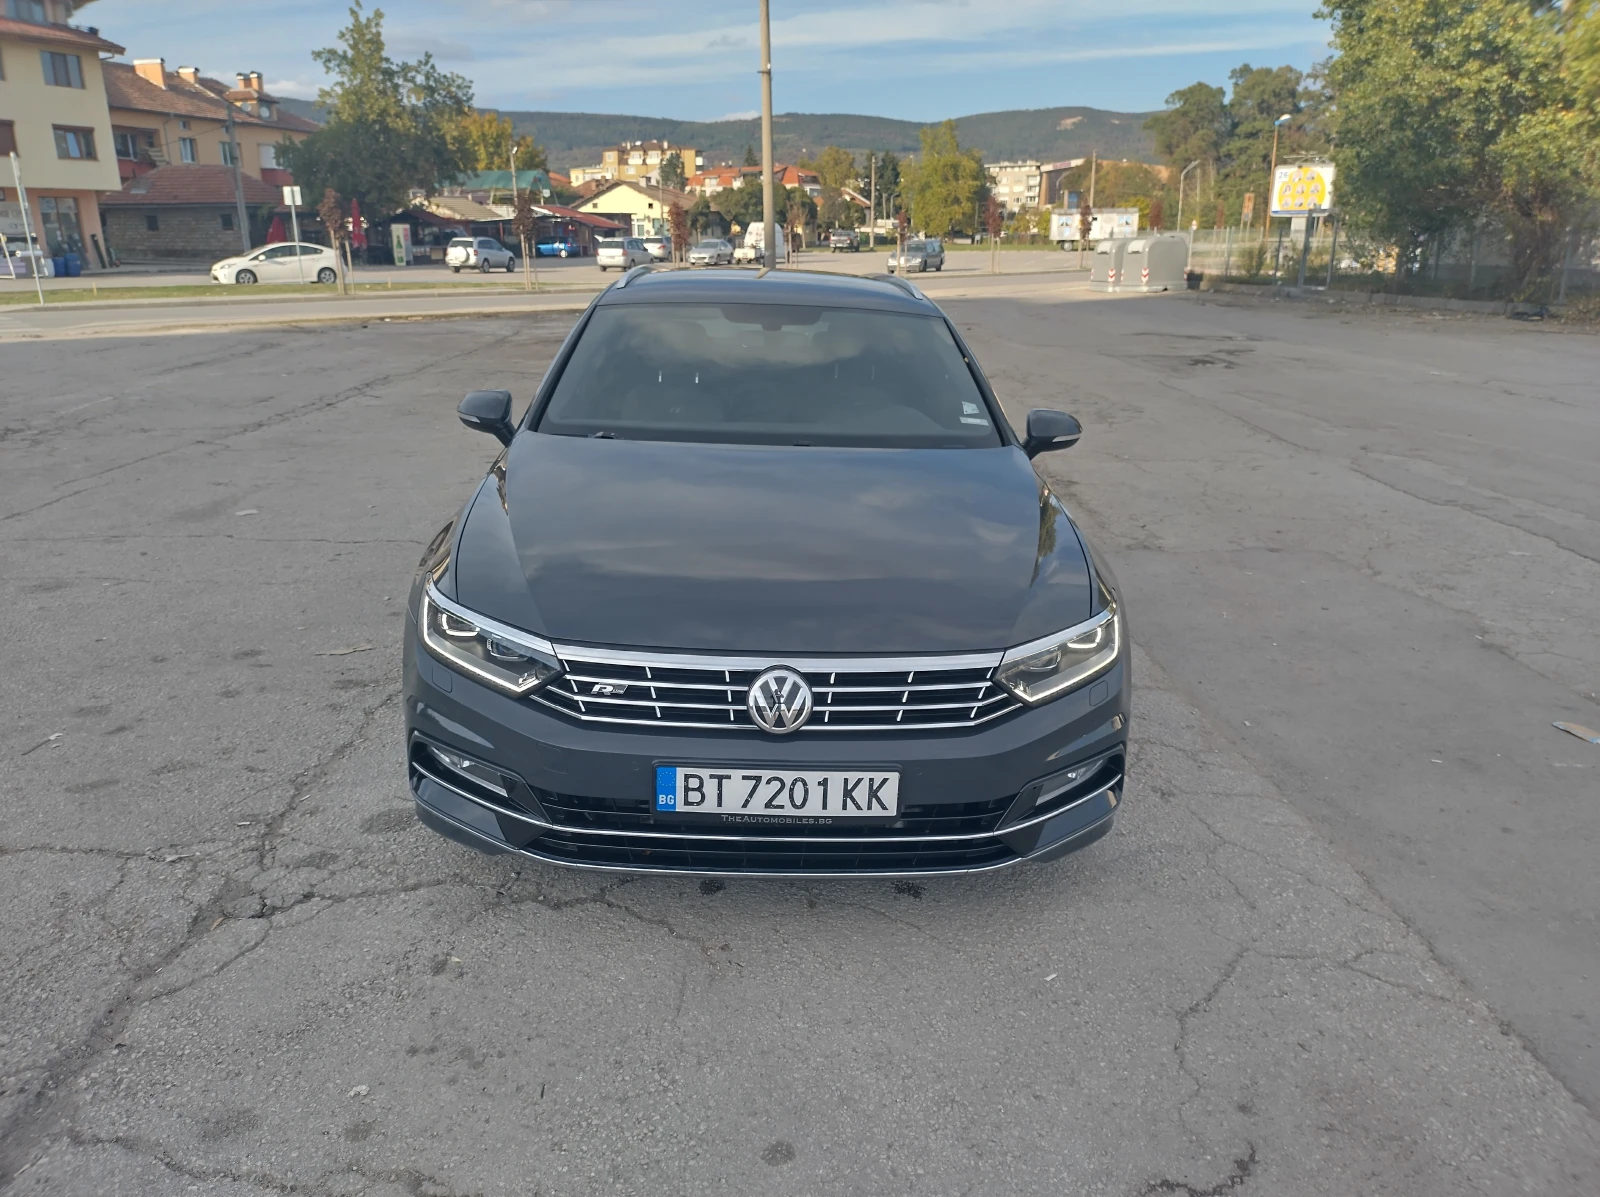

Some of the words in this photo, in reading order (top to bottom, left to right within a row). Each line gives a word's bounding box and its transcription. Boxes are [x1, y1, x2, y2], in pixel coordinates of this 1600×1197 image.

[591, 684, 613, 695] R
[683, 773, 732, 808] BT
[741, 775, 829, 811] 7201
[841, 777, 890, 811] KK
[658, 794, 675, 805] BG
